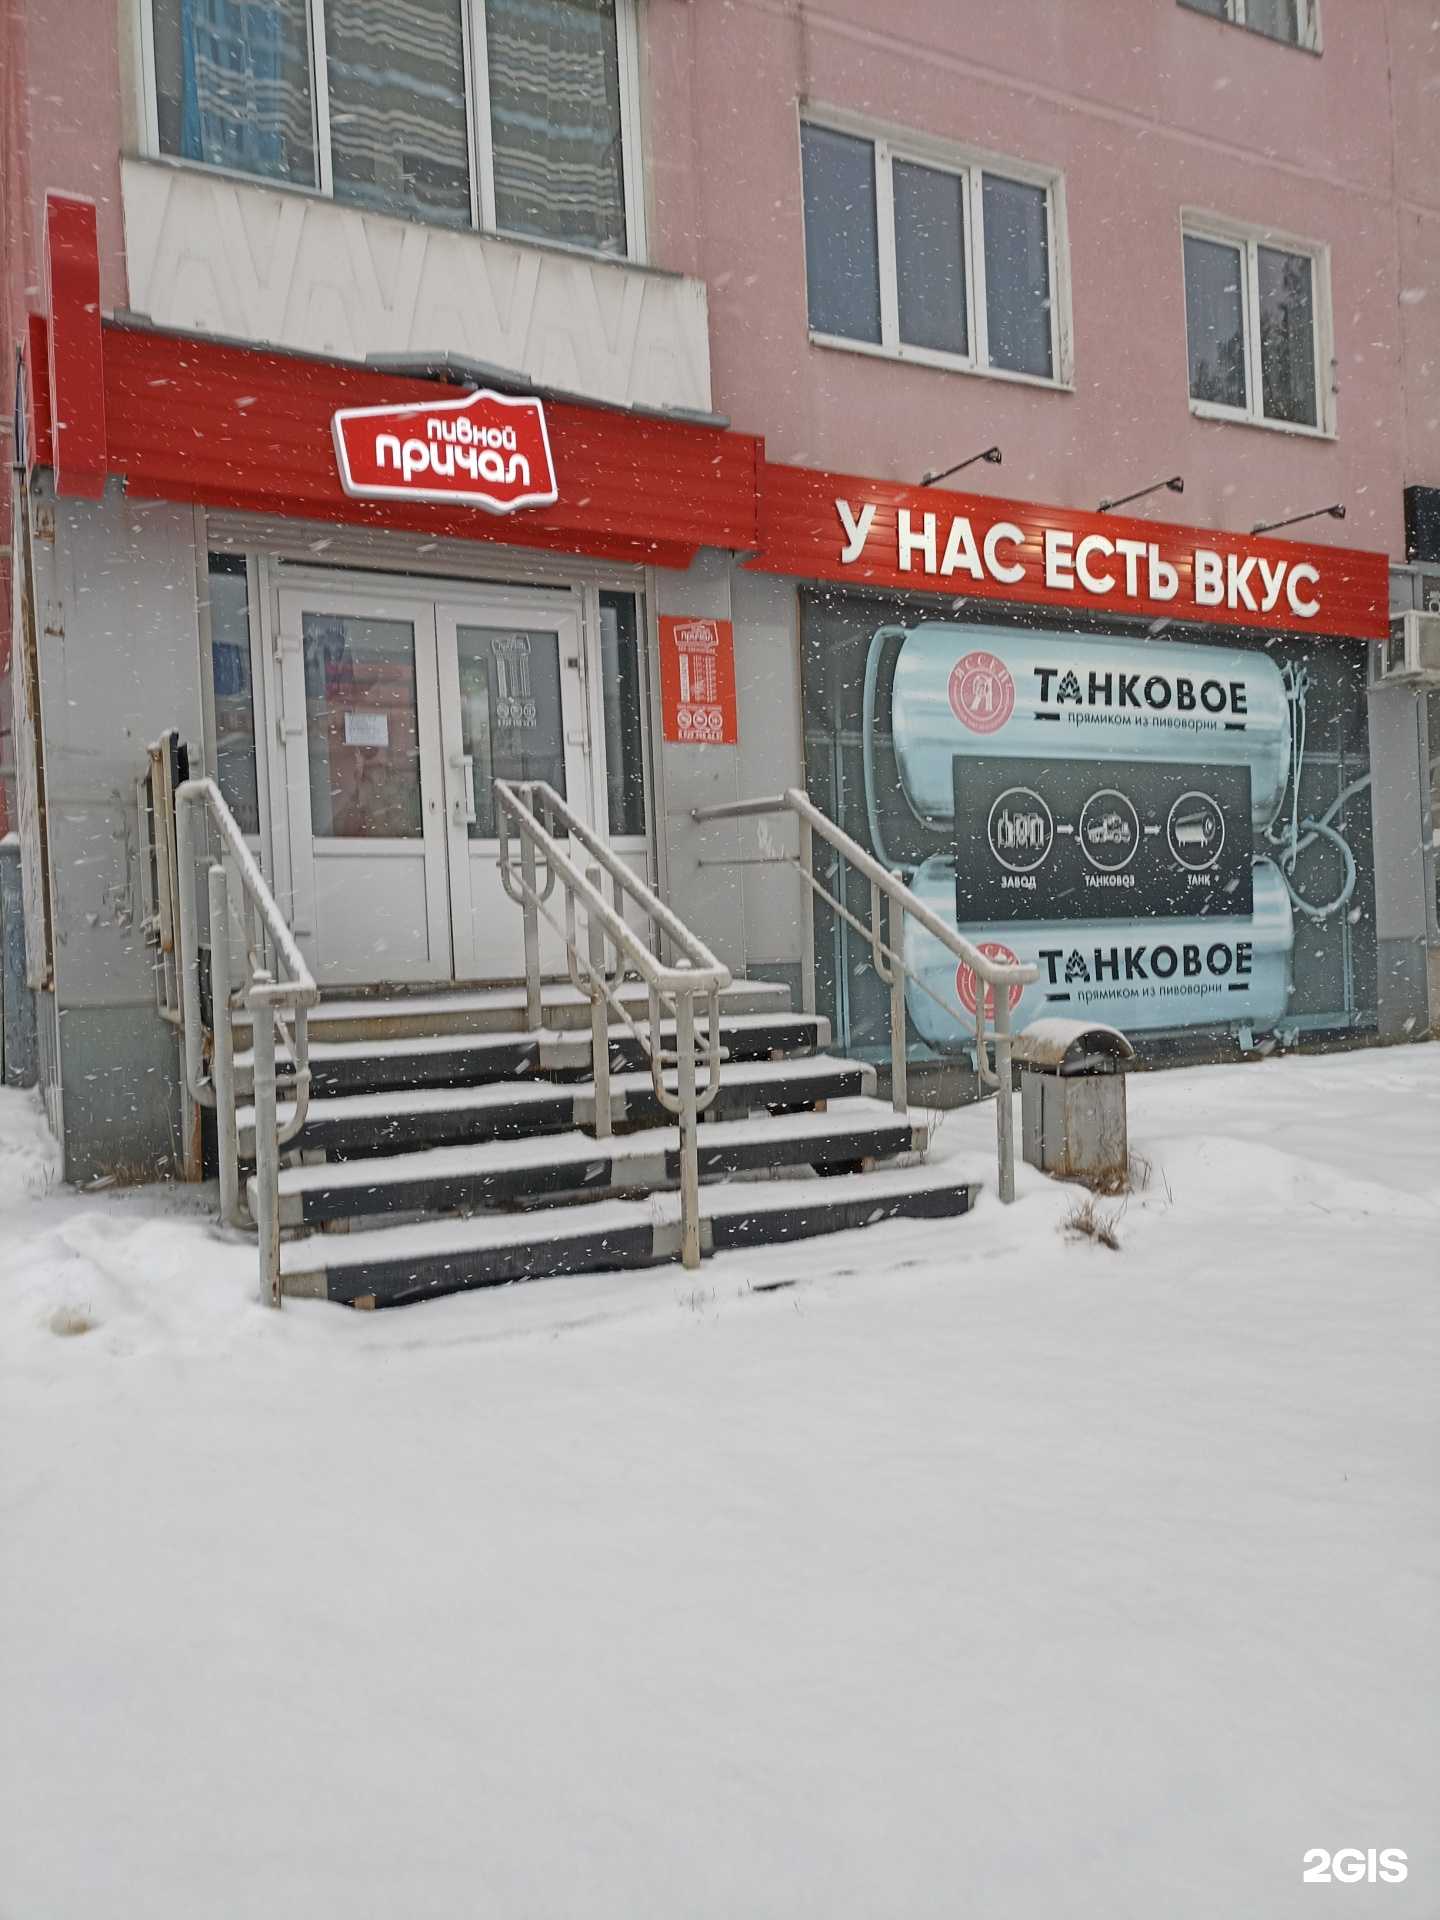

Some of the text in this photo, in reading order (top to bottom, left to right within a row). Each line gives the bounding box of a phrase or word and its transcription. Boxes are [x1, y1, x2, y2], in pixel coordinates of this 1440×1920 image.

[375, 433, 530, 486] причал
[835, 499, 1320, 618] У НАС ЕСТЬ ВКУС
[1033, 667, 1248, 716] ТАНКОВОЕ
[1068, 712, 1217, 732] прямиком из пивоварни
[1001, 874, 1211, 890] ЗАВОД ТАНКОВОЗ ТАНК
[1038, 942, 1252, 985] ТАНКОВОЕ
[1077, 983, 1222, 1005] прямиком из пивоварни
